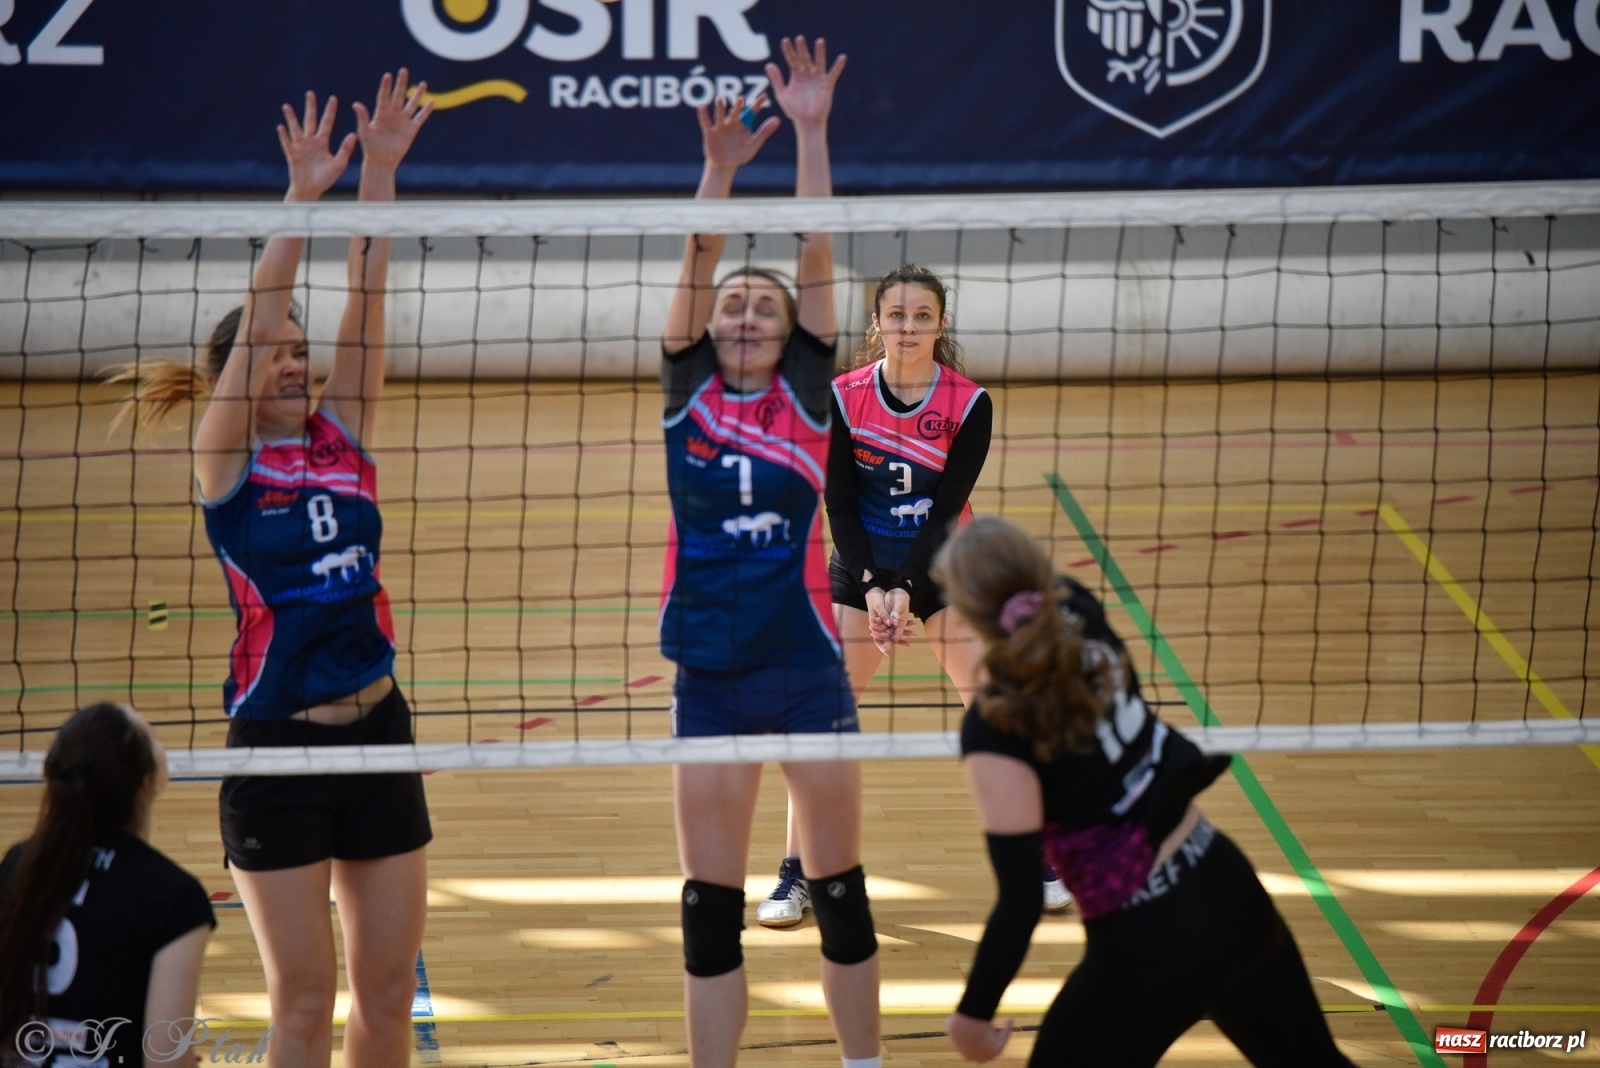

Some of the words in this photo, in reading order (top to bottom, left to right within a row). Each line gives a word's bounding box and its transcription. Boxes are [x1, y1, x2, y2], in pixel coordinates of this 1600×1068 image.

[0, 0, 104, 65] Z
[550, 65, 770, 108] RACIBÓRZ
[721, 454, 753, 506] 7
[888, 462, 912, 496] 3
[307, 494, 339, 543] 8
